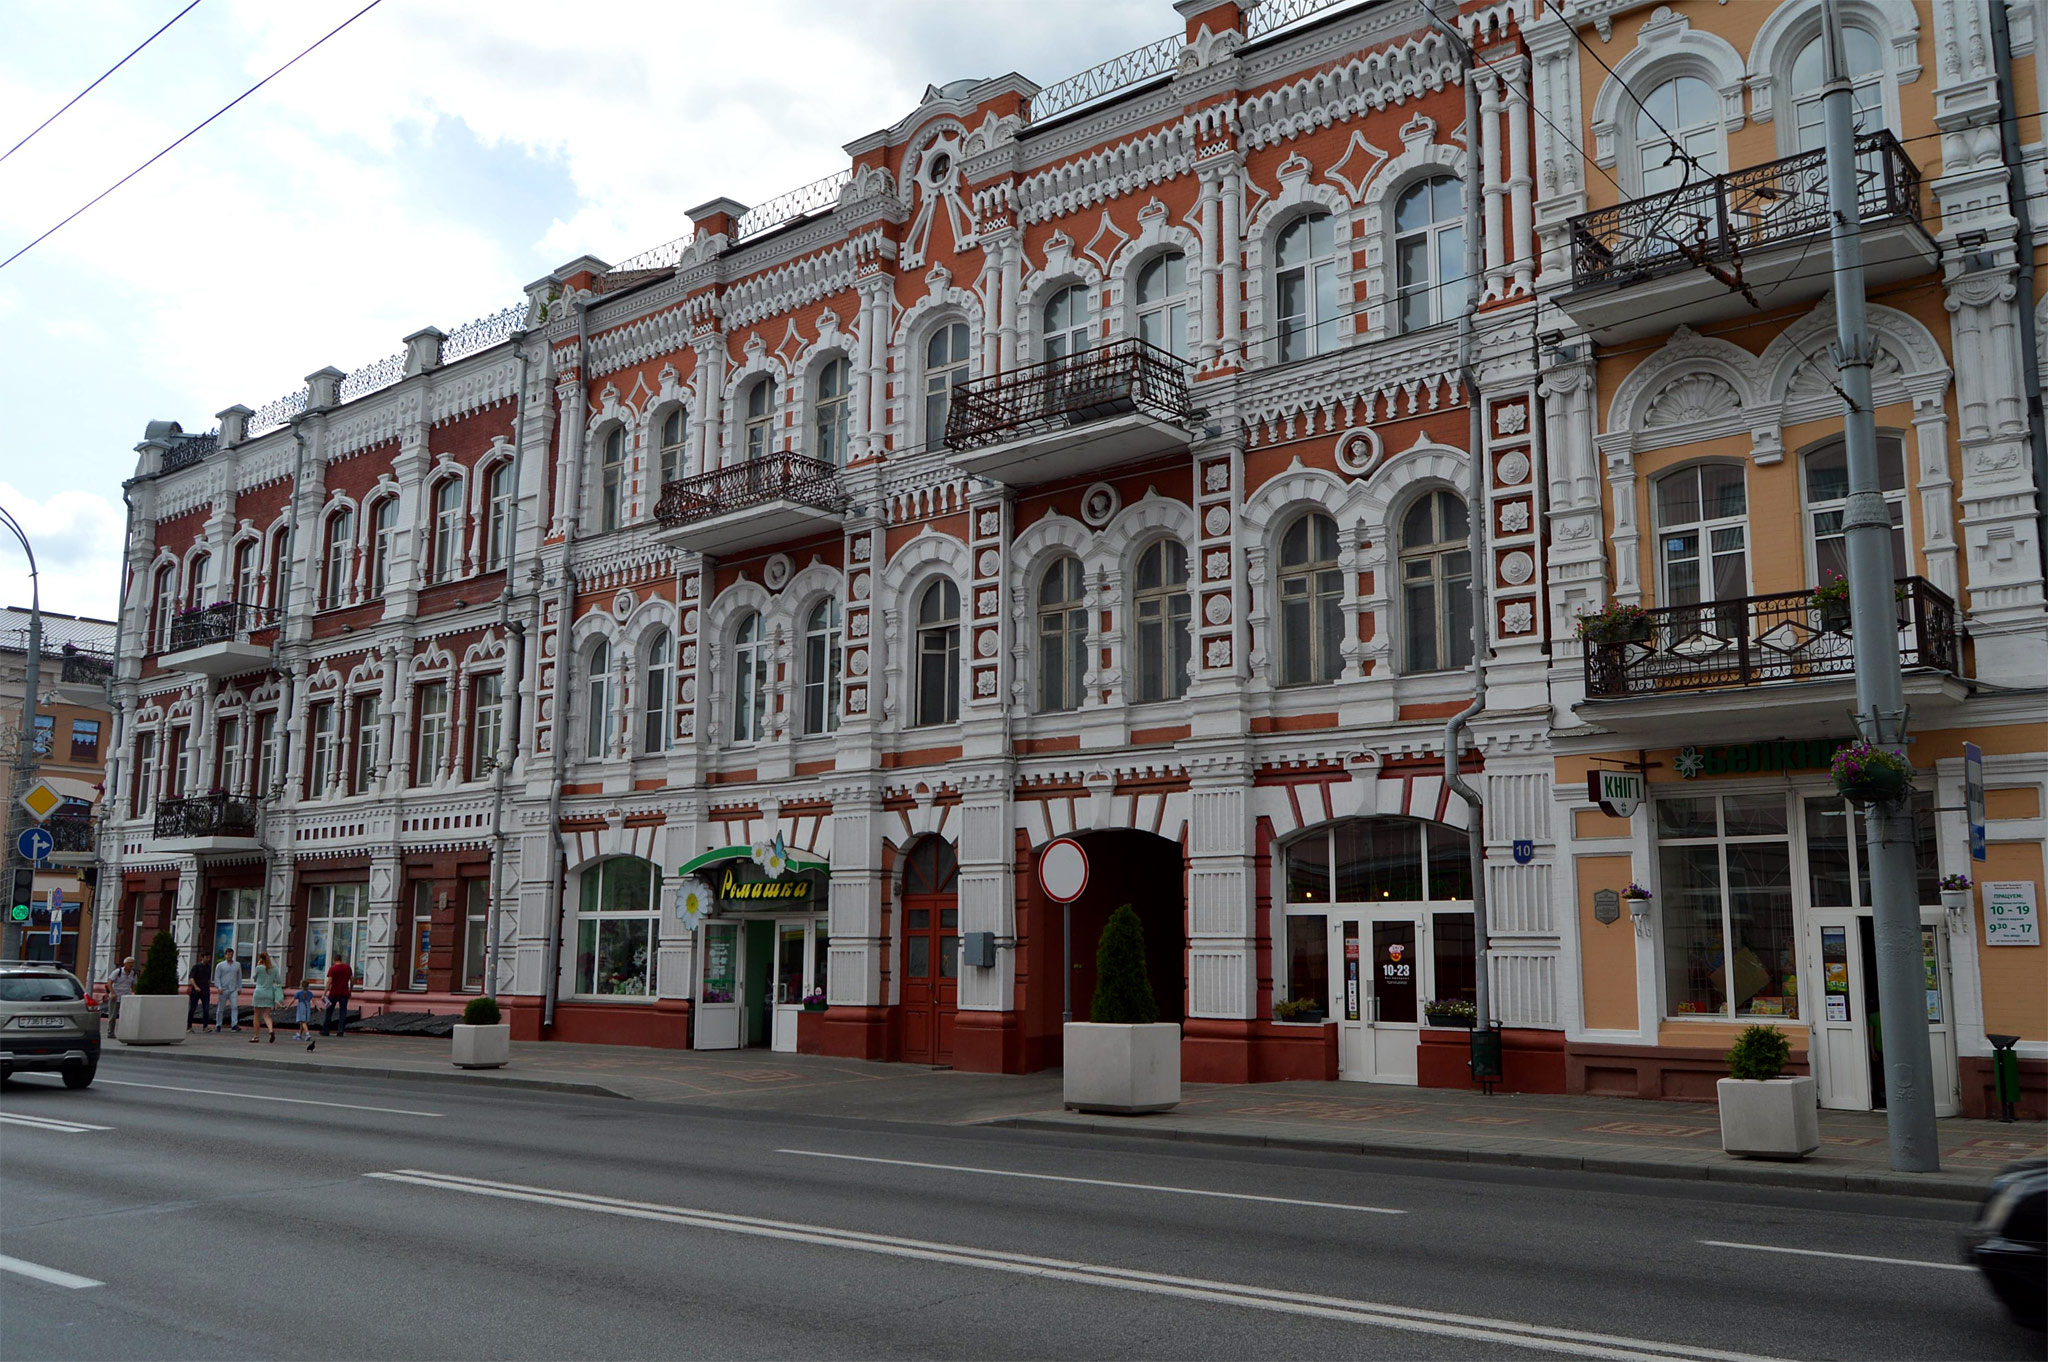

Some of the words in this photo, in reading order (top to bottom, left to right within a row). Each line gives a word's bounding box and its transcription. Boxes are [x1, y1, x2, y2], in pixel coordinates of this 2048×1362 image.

[1604, 775, 1640, 799] КНІГІ
[1516, 845, 1530, 857] 10
[721, 869, 808, 899] Ромашка
[1990, 905, 2004, 915] 10
[2016, 905, 2030, 915] 19
[2019, 923, 2032, 933] 17
[1382, 964, 1410, 976] 10-23
